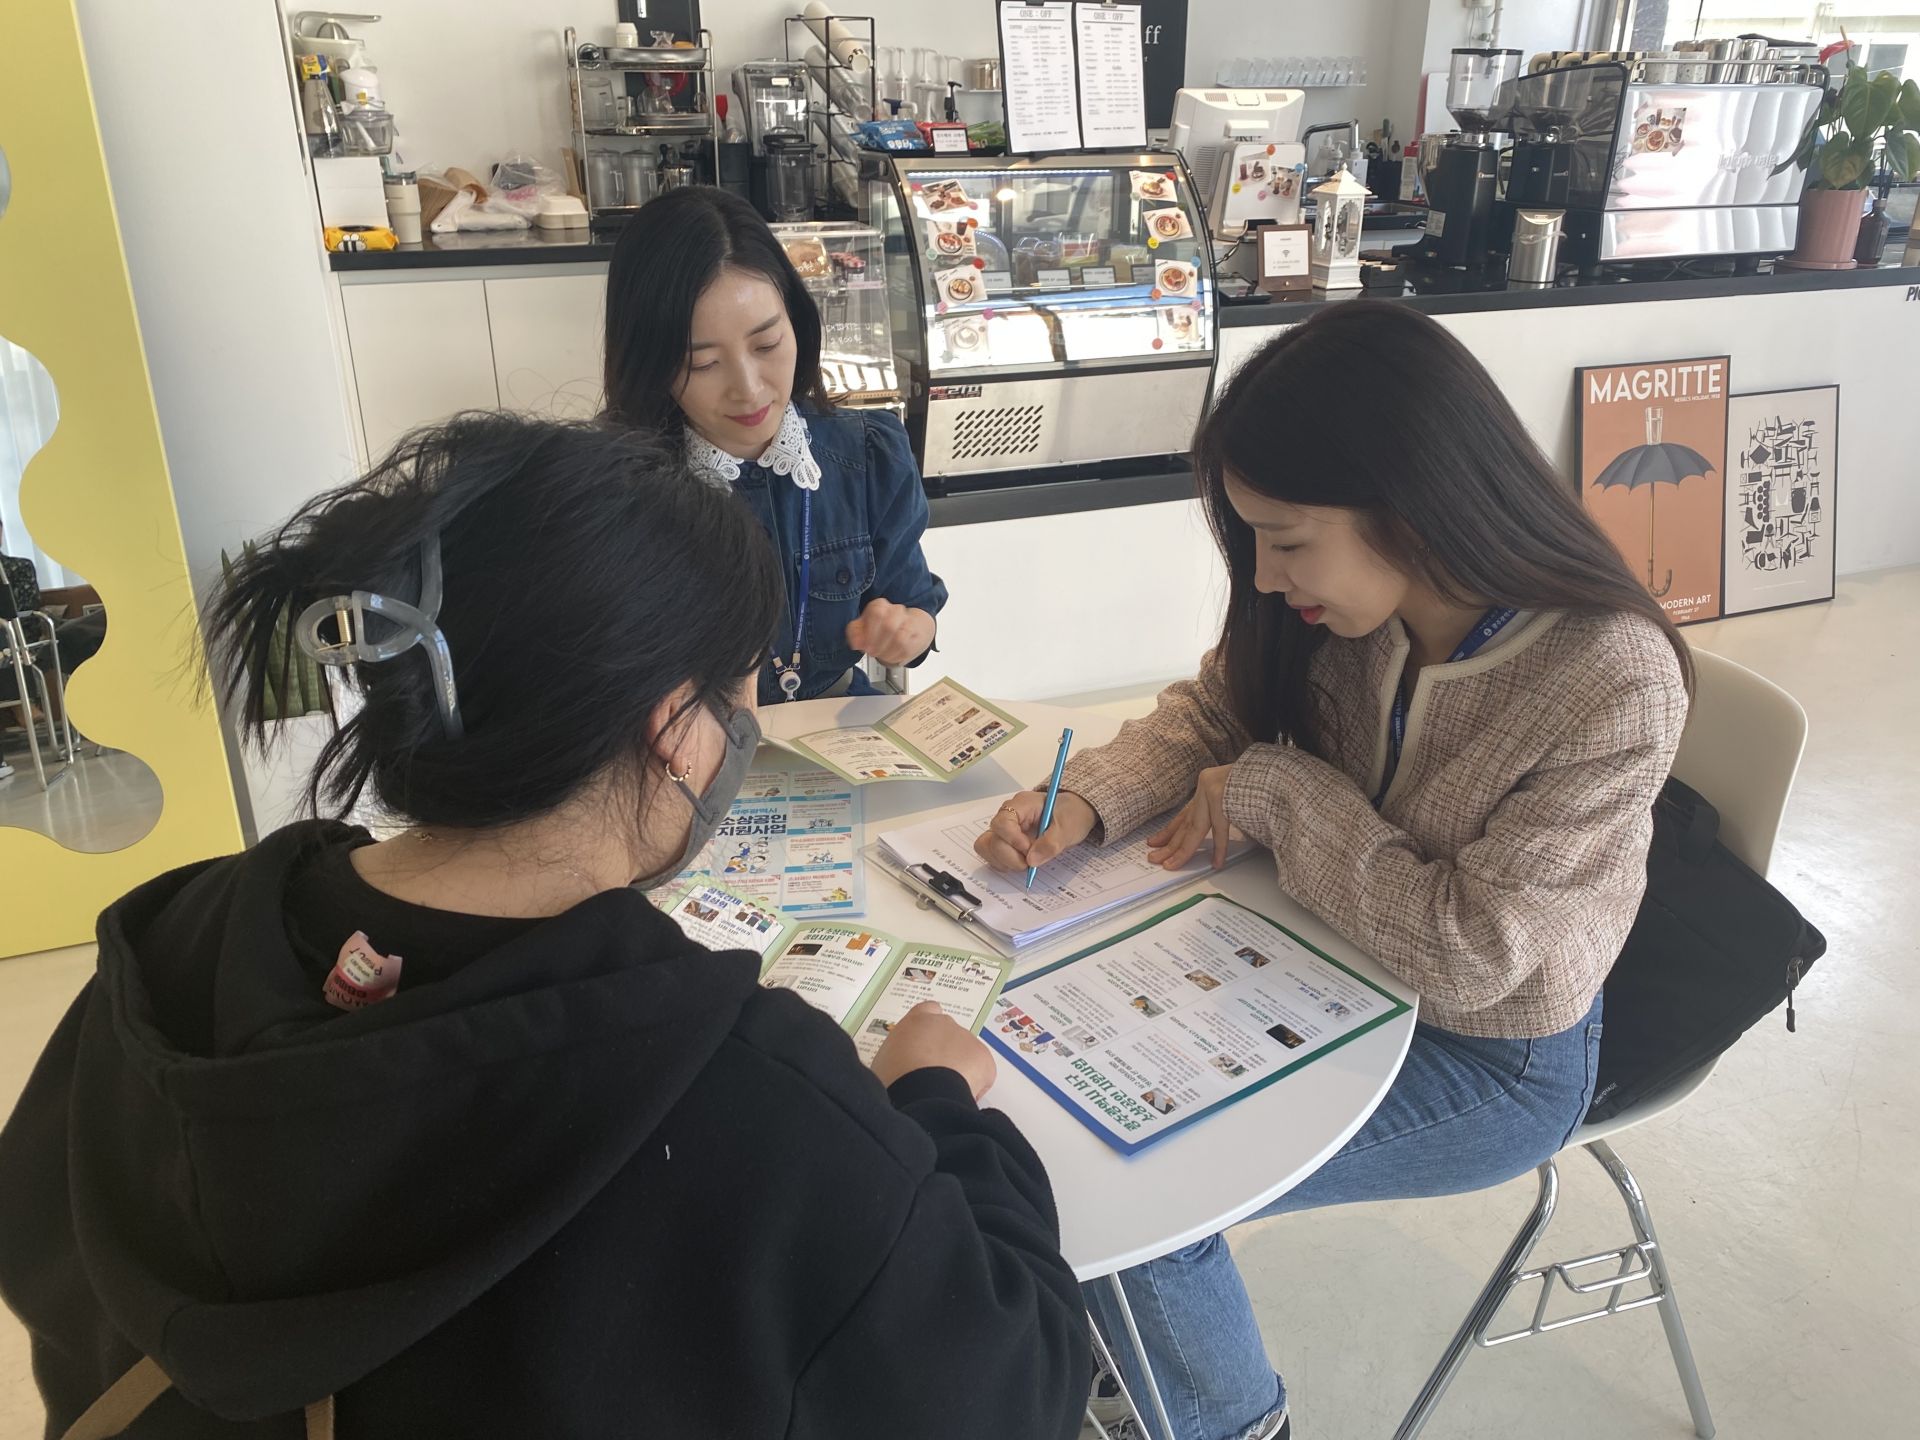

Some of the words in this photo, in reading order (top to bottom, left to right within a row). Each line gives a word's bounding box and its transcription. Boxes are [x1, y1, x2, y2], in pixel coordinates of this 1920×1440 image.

[1590, 363, 1722, 405] MAGRITTE
[1660, 597, 1694, 610] MODERN
[1696, 594, 1711, 605] ART
[720, 814, 787, 826] 소상공인
[717, 824, 787, 836] 지원사업
[826, 928, 857, 937] 소상공인
[933, 952, 965, 964] 소상공인
[1065, 1074, 1091, 1091] 서구
[1070, 1058, 1116, 1092] 지원사업
[1085, 1089, 1141, 1132] 광주광역시
[1110, 1089, 1158, 1122] 소상공인
